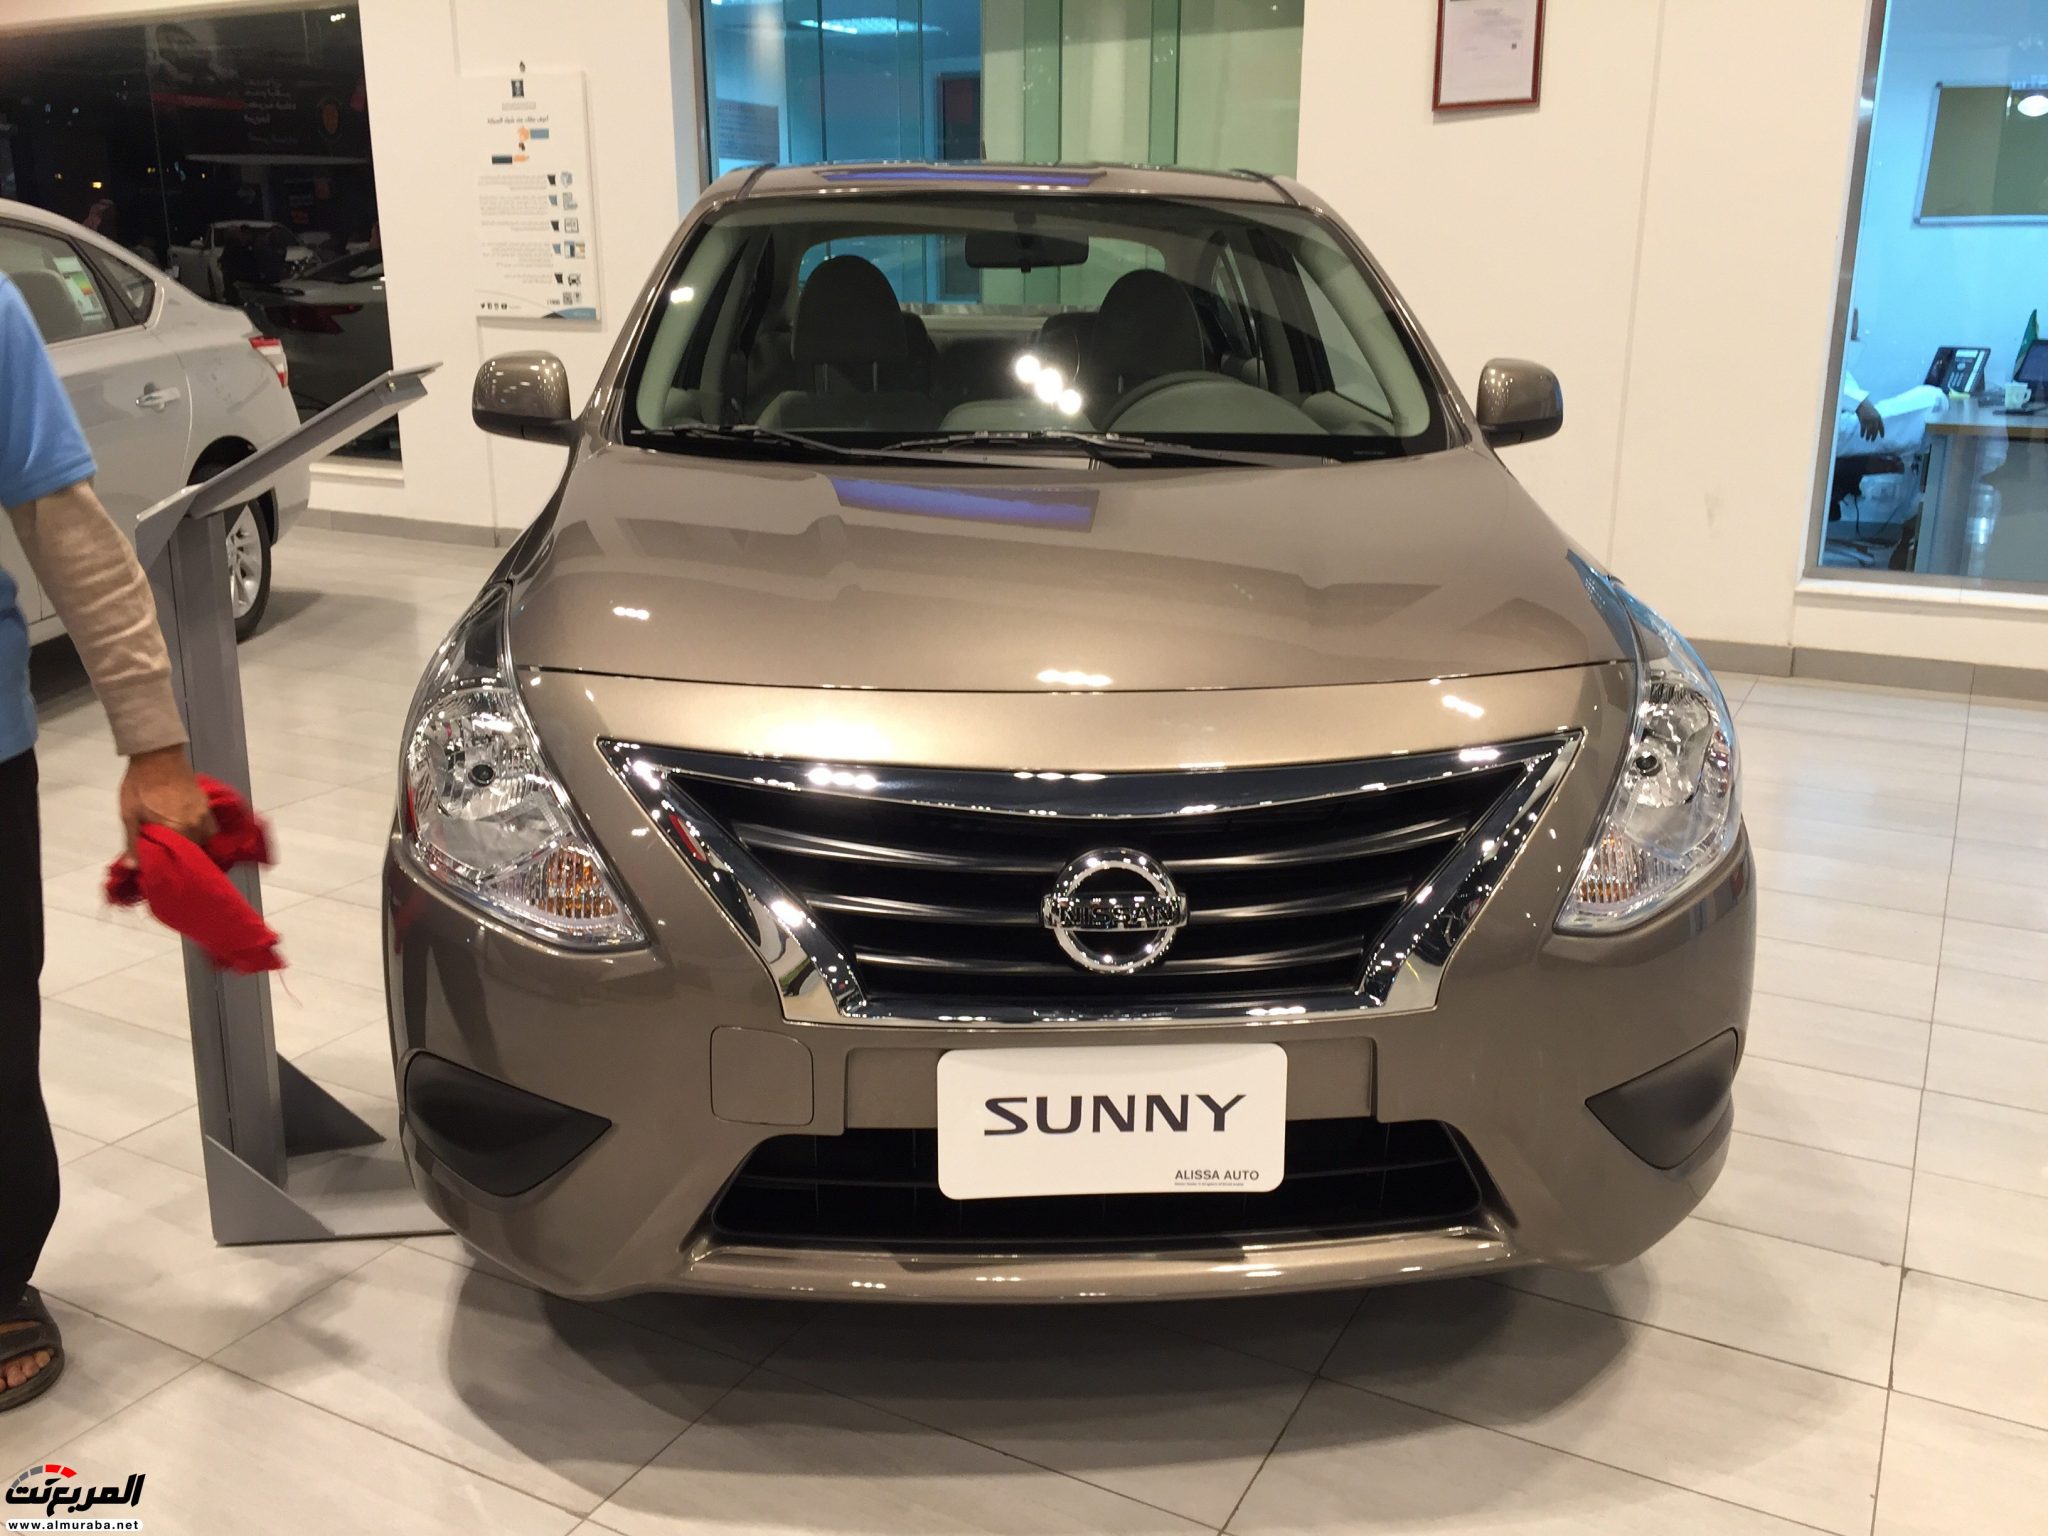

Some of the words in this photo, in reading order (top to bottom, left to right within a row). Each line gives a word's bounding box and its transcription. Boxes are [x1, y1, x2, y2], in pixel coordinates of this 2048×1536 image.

[1057, 906, 1173, 928] NISSAN
[984, 1094, 1247, 1136] SUNNY
[1174, 1169, 1220, 1181] ALISSA
[1223, 1169, 1260, 1181] AUTO
